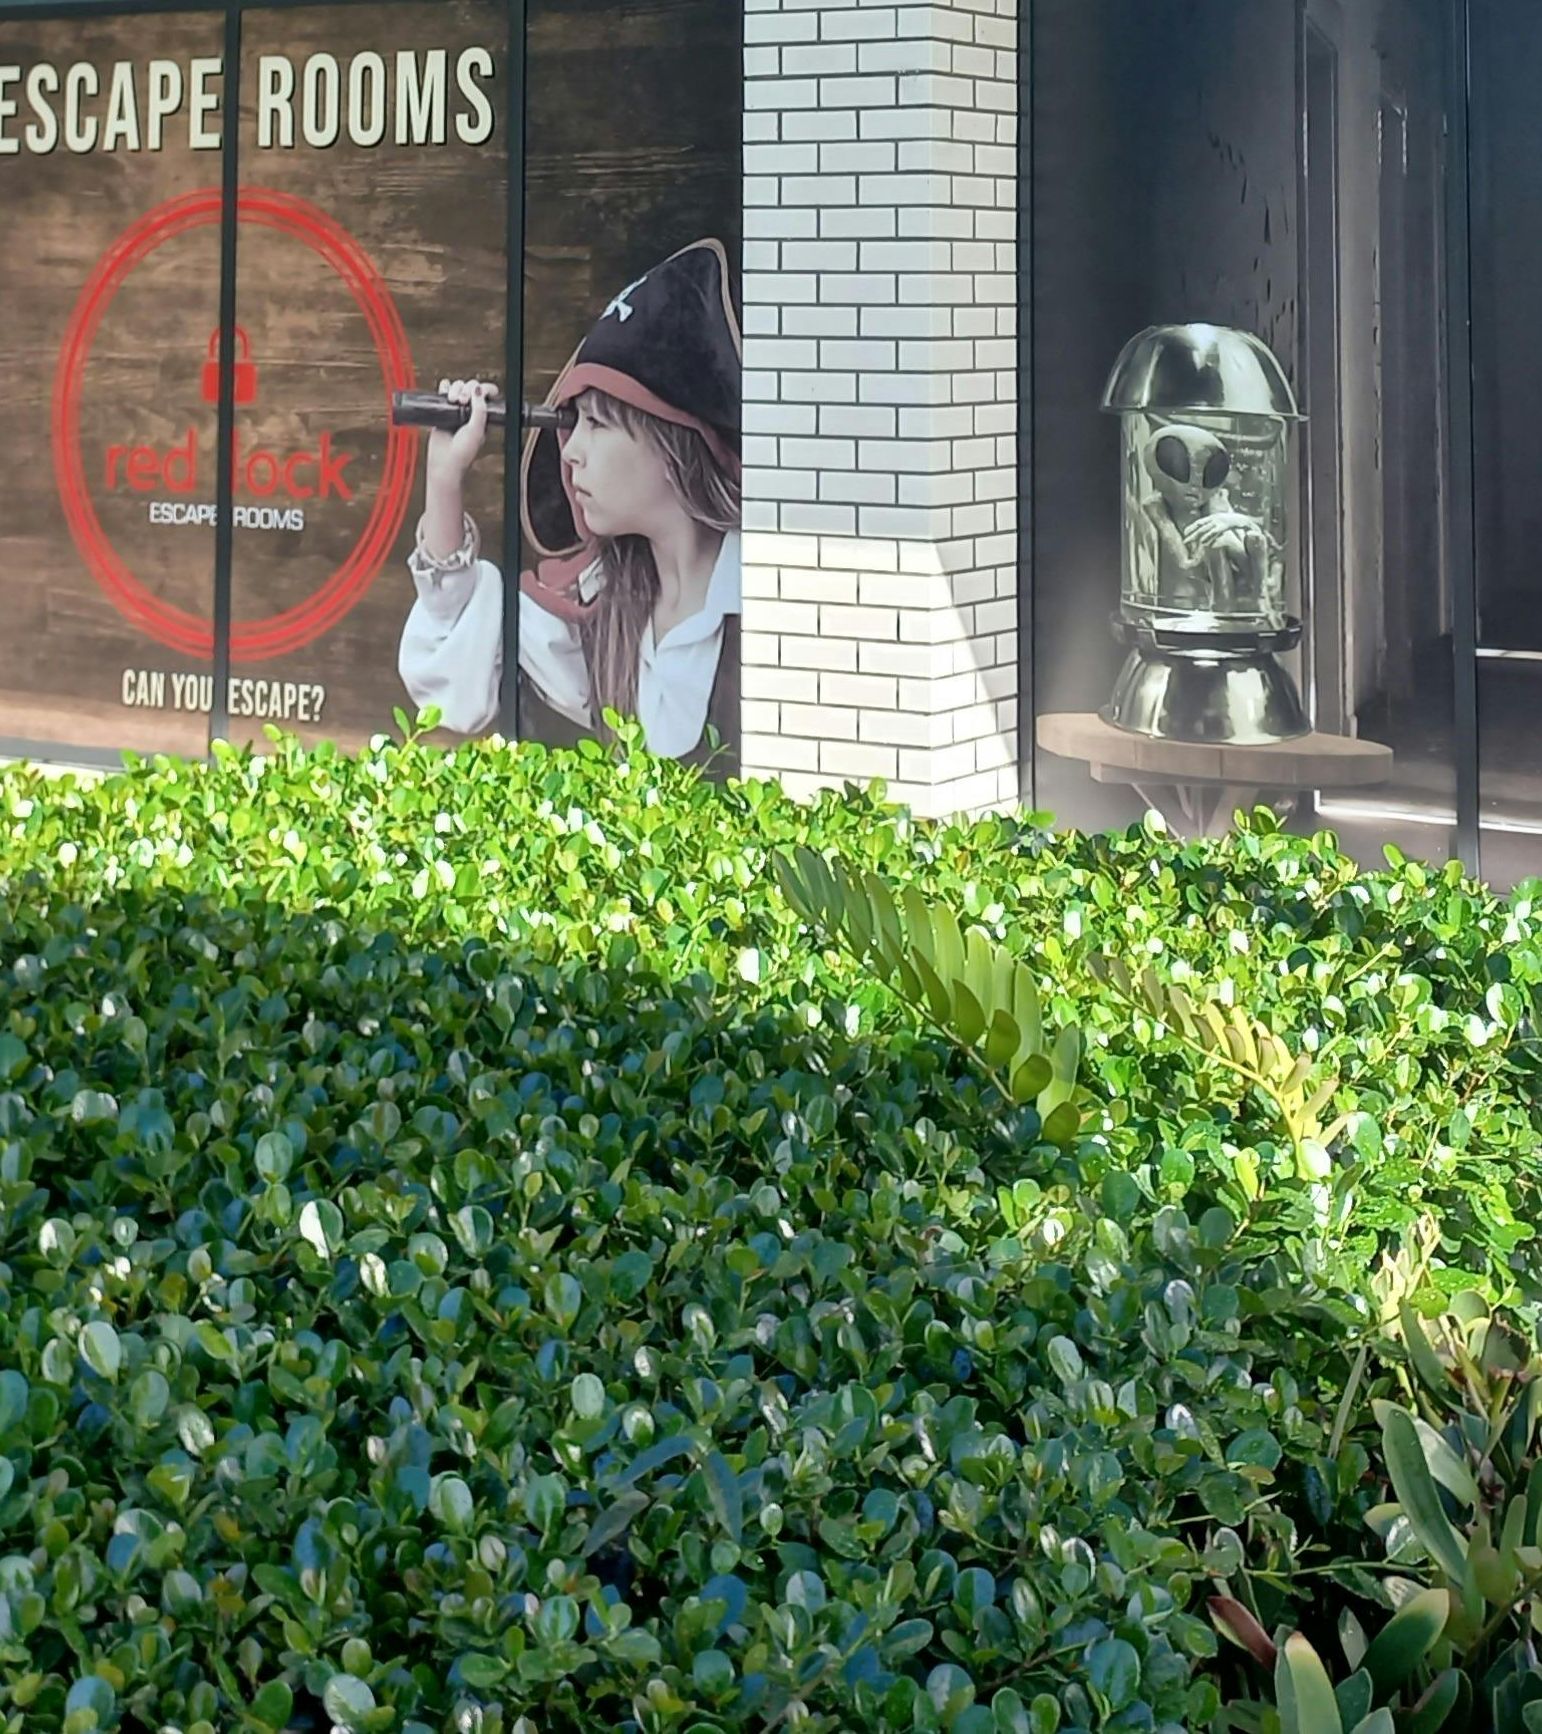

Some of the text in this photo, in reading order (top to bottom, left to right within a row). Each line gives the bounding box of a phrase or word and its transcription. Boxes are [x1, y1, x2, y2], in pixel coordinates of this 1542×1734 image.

[258, 46, 495, 149] ROOMS
[105, 426, 353, 501] red lock
[232, 505, 304, 531] ROOMS
[121, 668, 325, 722] CAN YOU ESCAPE?
